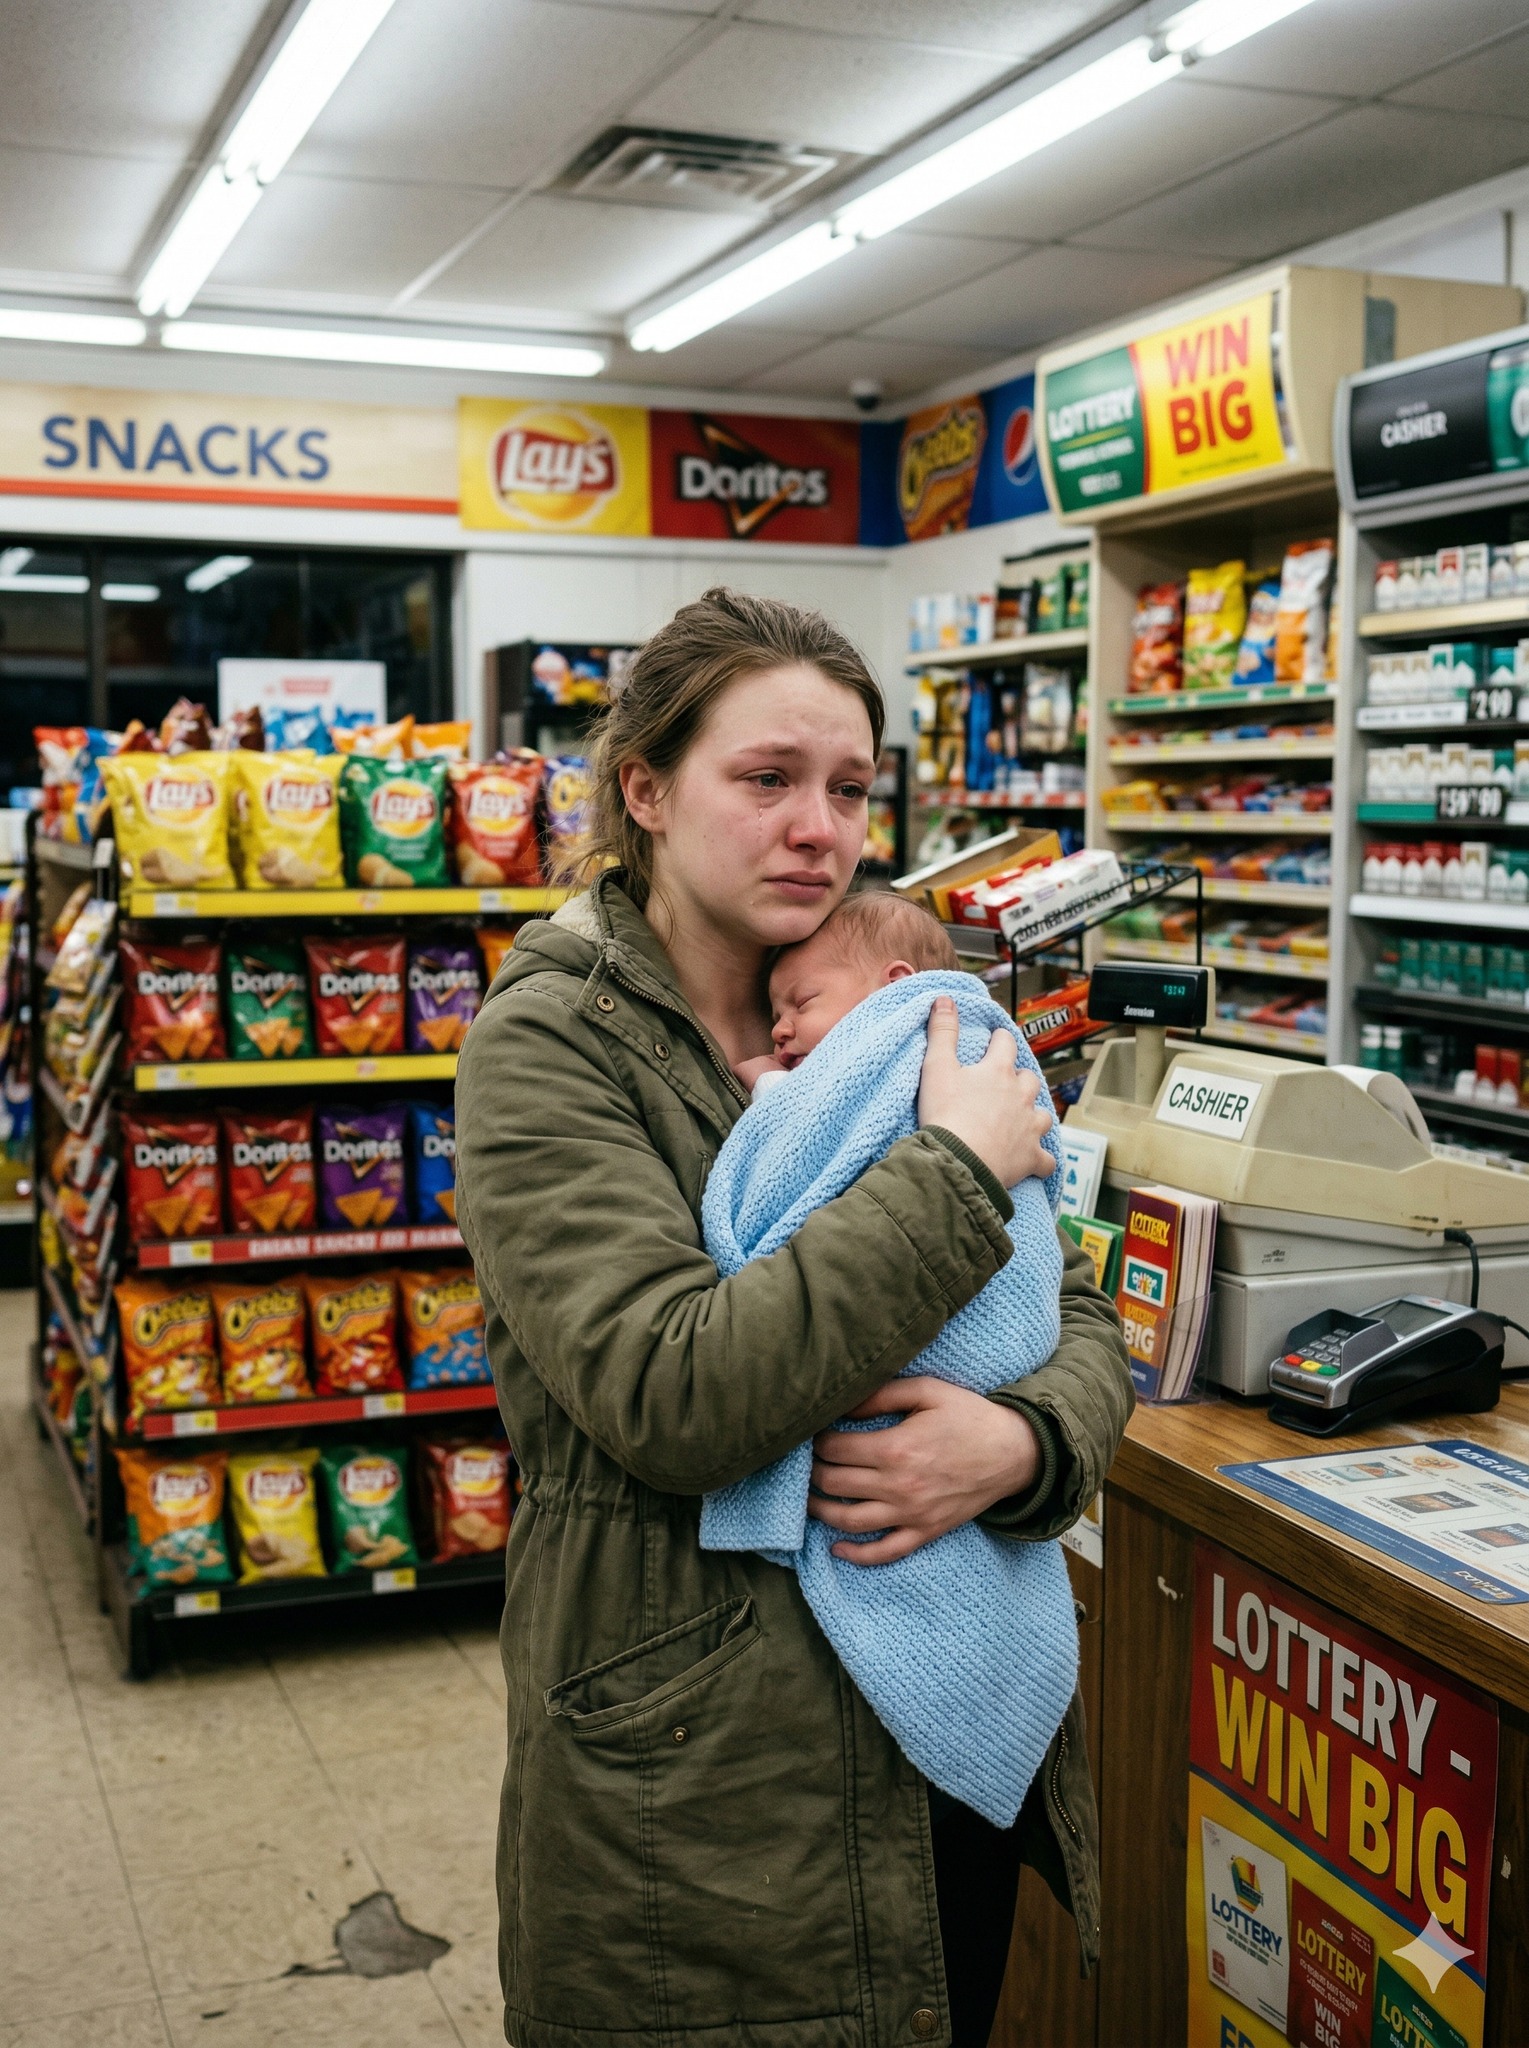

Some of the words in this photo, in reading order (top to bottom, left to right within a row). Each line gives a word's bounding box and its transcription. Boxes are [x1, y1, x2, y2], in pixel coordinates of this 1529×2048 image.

[1165, 316, 1249, 388] WIN
[1047, 386, 1137, 442] LOTTERY
[1169, 380, 1253, 456] BIG
[42, 414, 331, 482] SNACKS
[499, 429, 613, 494] Lay's
[680, 456, 828, 503] Doritos
[137, 970, 219, 995] Doritos
[231, 970, 306, 994] Doritos
[320, 972, 400, 997] Doritos
[408, 967, 480, 991] Doritos
[1022, 1007, 1071, 1039] LOTTERY
[1168, 1082, 1250, 1122] CASHIER
[134, 1142, 218, 1168] Doritos
[232, 1141, 313, 1167] Doritos
[323, 1139, 402, 1163] Doritos
[1129, 1210, 1171, 1240] LOTTERY
[1212, 1572, 1437, 1776] LOTTERY
[1211, 1662, 1330, 1839] WIN
[1348, 1752, 1467, 1938] BIG
[1211, 1892, 1283, 1956] LOTTERY
[1297, 1919, 1367, 1997] LOTTERY
[1314, 1997, 1341, 2037] WIN
[1314, 2020, 1341, 2048] BIG
